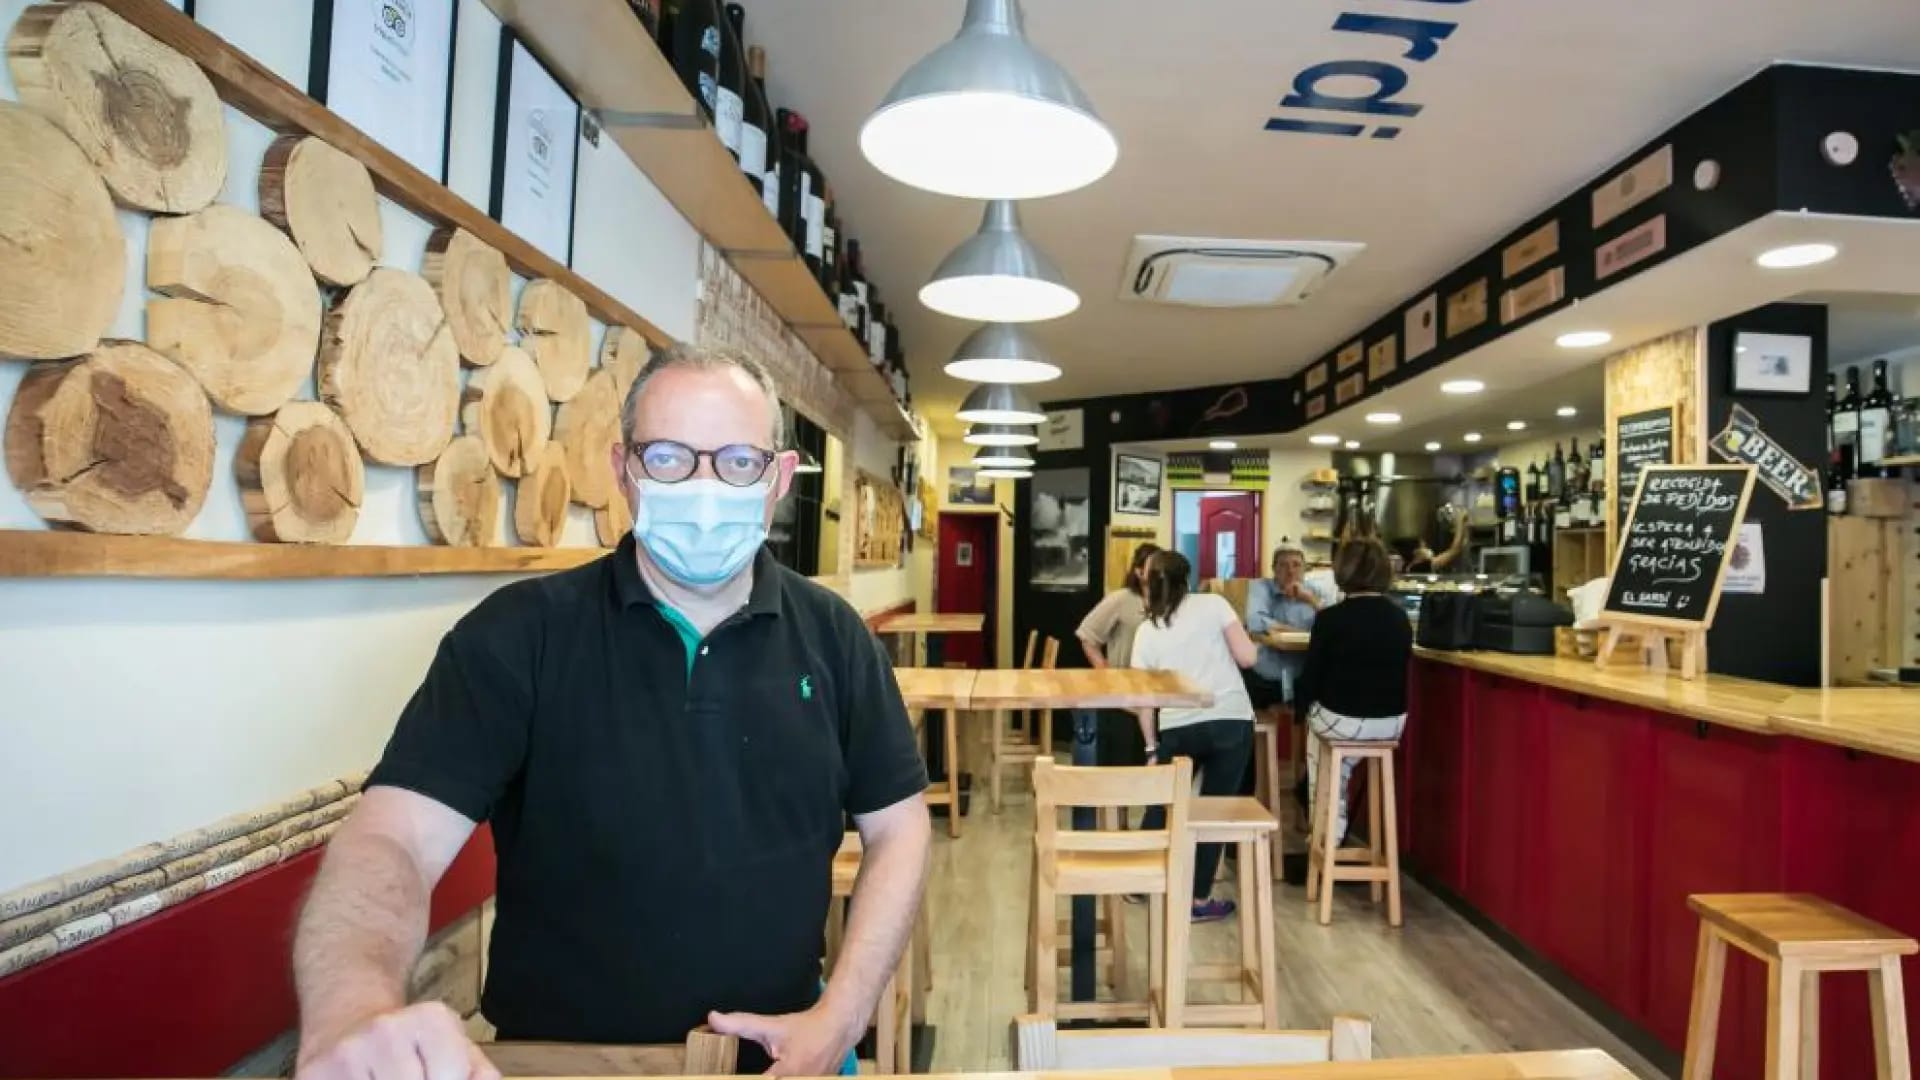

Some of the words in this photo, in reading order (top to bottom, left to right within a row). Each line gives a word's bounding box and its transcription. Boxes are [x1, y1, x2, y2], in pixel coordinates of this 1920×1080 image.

[1264, 0, 1473, 138] rdi
[1742, 431, 1808, 496] BEER
[1650, 477, 1723, 496] RECOGIDA
[1633, 521, 1694, 537] ESPERA
[1629, 554, 1701, 584] GRACIAS
